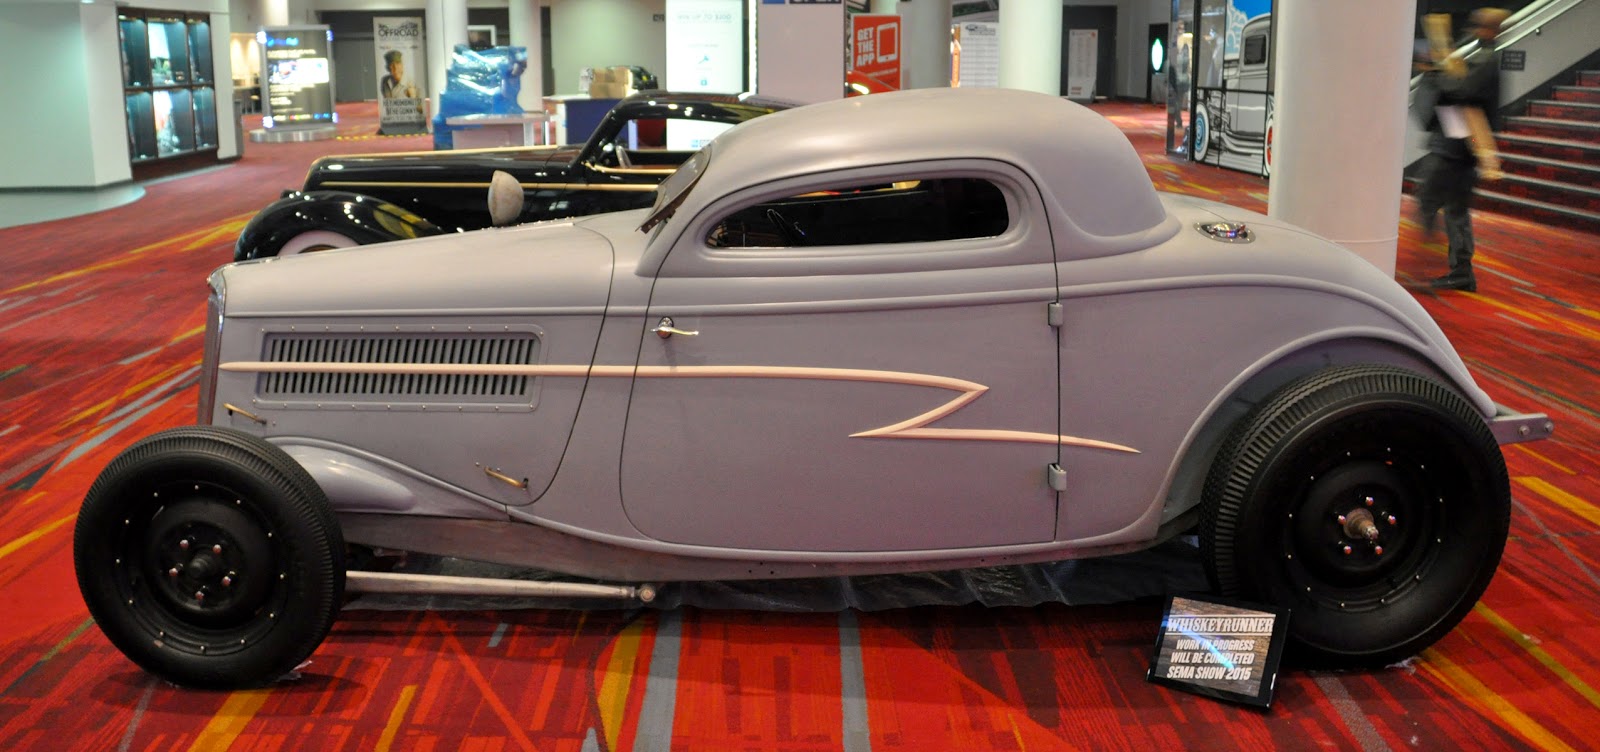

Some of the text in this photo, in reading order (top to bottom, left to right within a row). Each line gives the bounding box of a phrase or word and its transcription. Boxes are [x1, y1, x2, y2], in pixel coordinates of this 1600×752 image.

[378, 29, 419, 37] OFFROAD
[857, 27, 874, 40] GET
[857, 39, 874, 53] THE
[856, 52, 875, 67] APP
[1168, 617, 1275, 633] WHISKEYRUNNER
[1176, 639, 1255, 651] WORK IN PROGRESS
[1170, 652, 1255, 665] WILL BE COMPLETED
[1166, 666, 1252, 681] SEMA SHOW 2015
